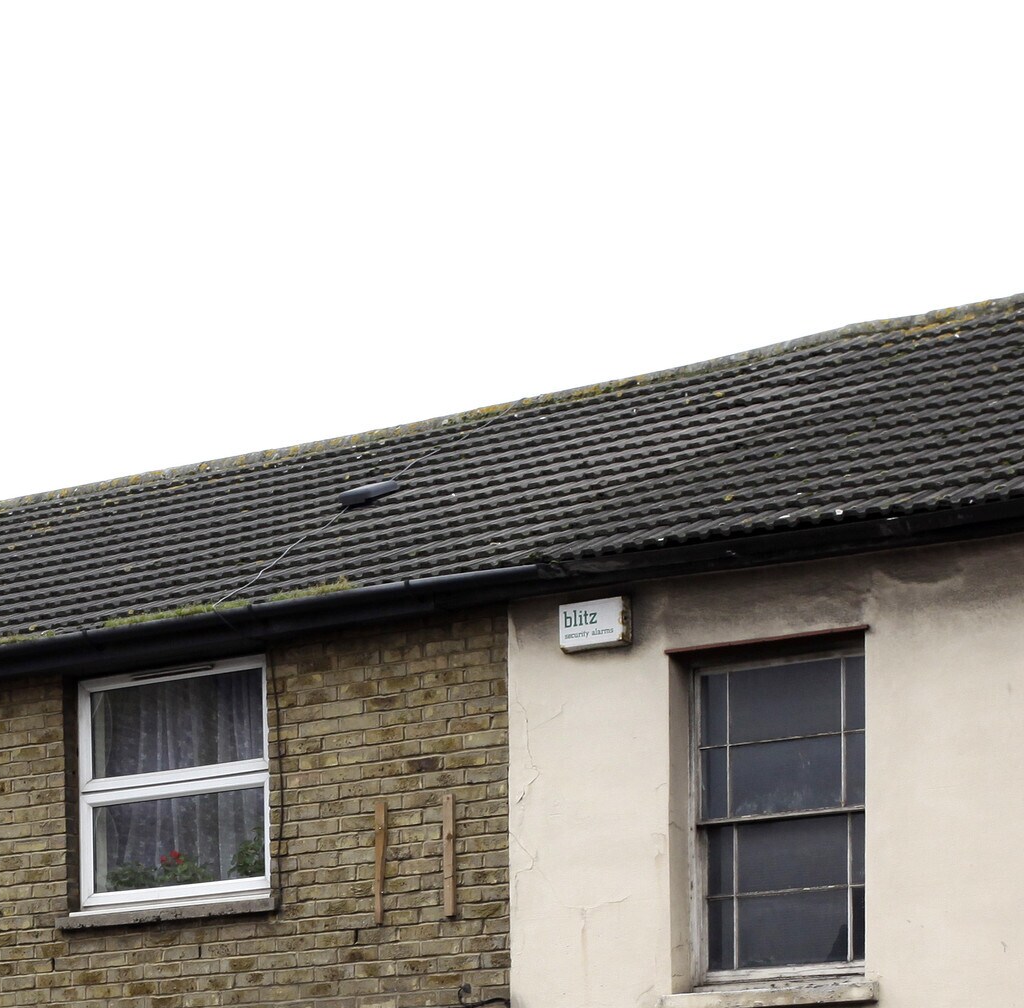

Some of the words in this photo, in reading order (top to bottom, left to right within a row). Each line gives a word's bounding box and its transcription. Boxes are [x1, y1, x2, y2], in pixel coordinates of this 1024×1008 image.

[564, 609, 597, 628] blitz
[564, 631, 590, 640] security
[592, 627, 614, 636] alarms
